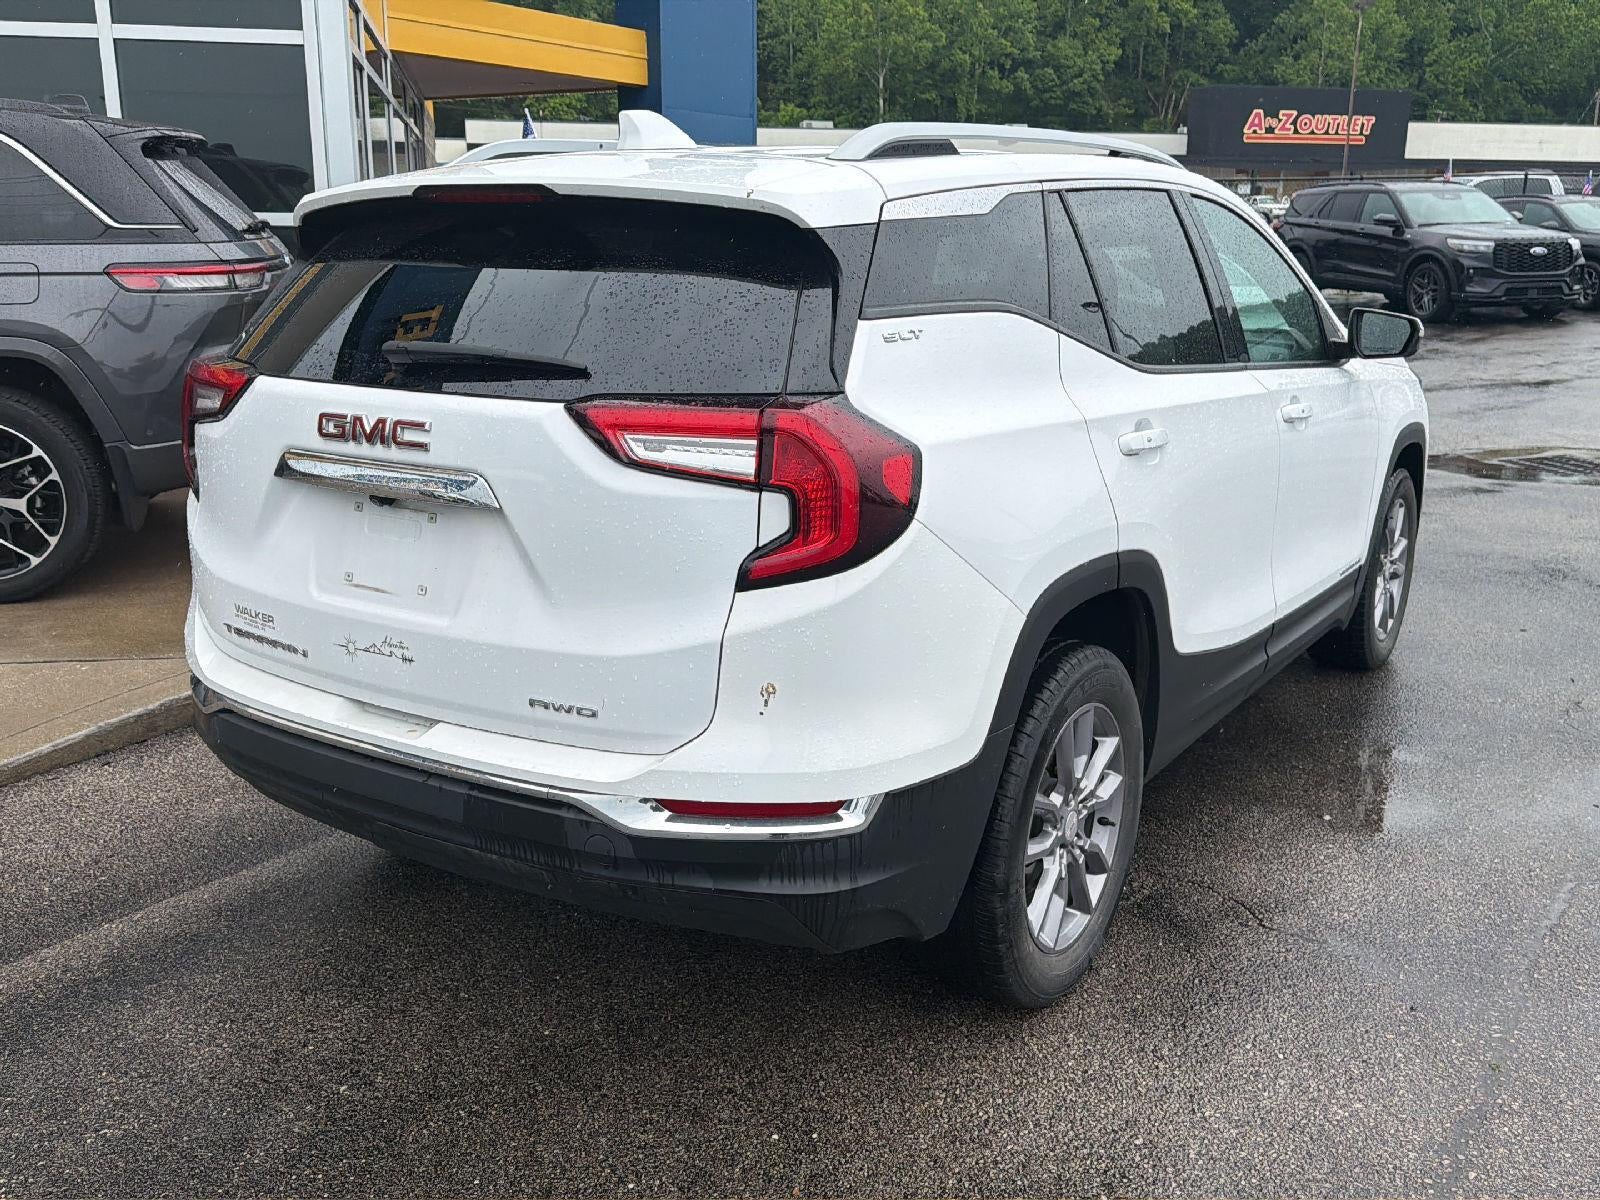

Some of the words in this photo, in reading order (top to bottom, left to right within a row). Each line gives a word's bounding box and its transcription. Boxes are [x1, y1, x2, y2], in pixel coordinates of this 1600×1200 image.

[1297, 114, 1376, 134] OUTLET
[317, 411, 432, 451] GMC
[234, 603, 275, 625] WALKER
[528, 698, 598, 718] AWD
